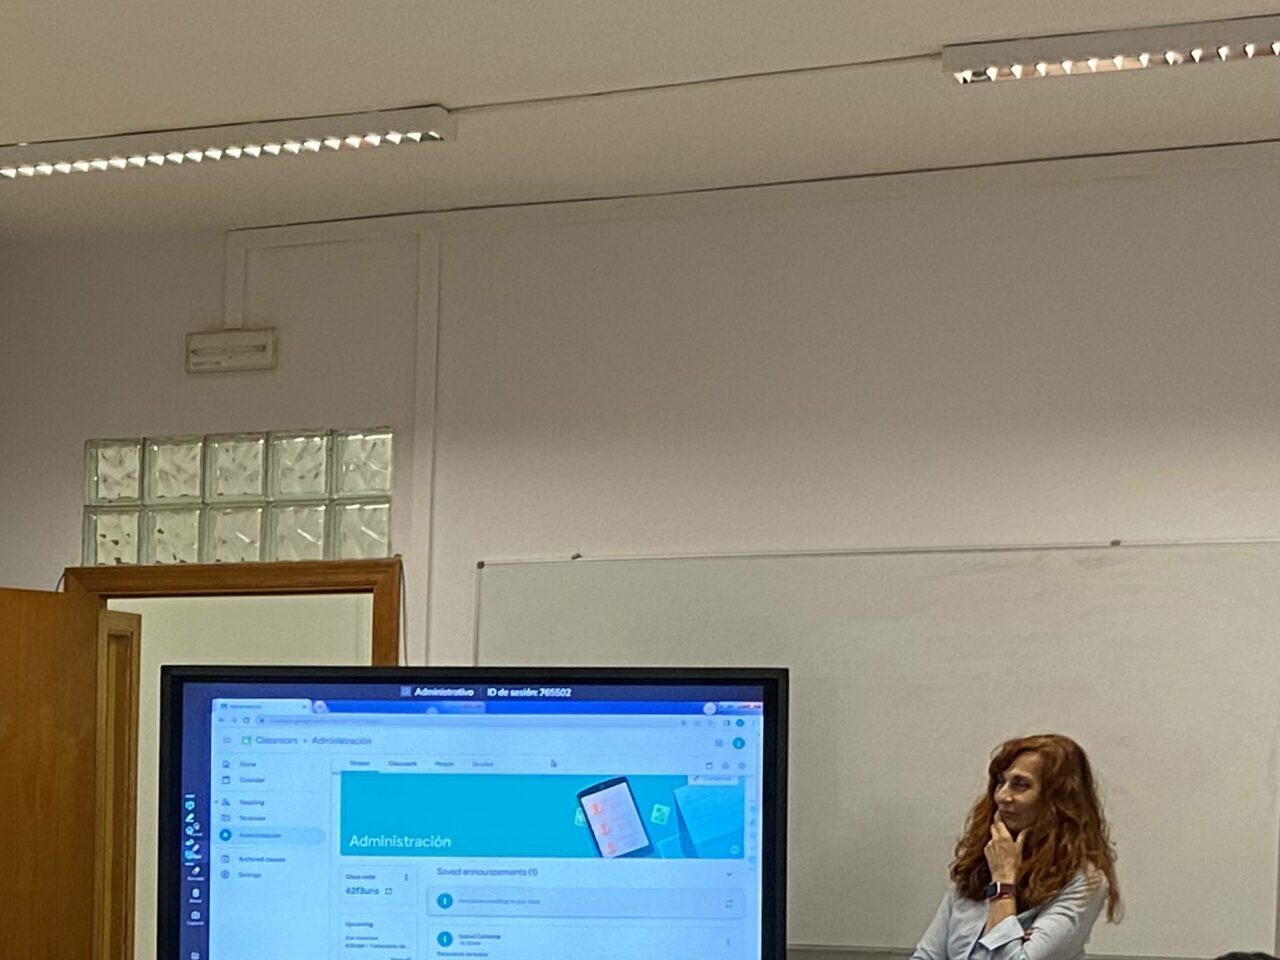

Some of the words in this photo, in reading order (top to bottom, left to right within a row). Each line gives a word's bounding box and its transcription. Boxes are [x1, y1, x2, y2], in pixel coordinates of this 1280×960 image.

[414, 687, 475, 697] Administrativo
[487, 688, 497, 697] ID
[498, 688, 509, 697] de
[348, 835, 452, 848] Administración
